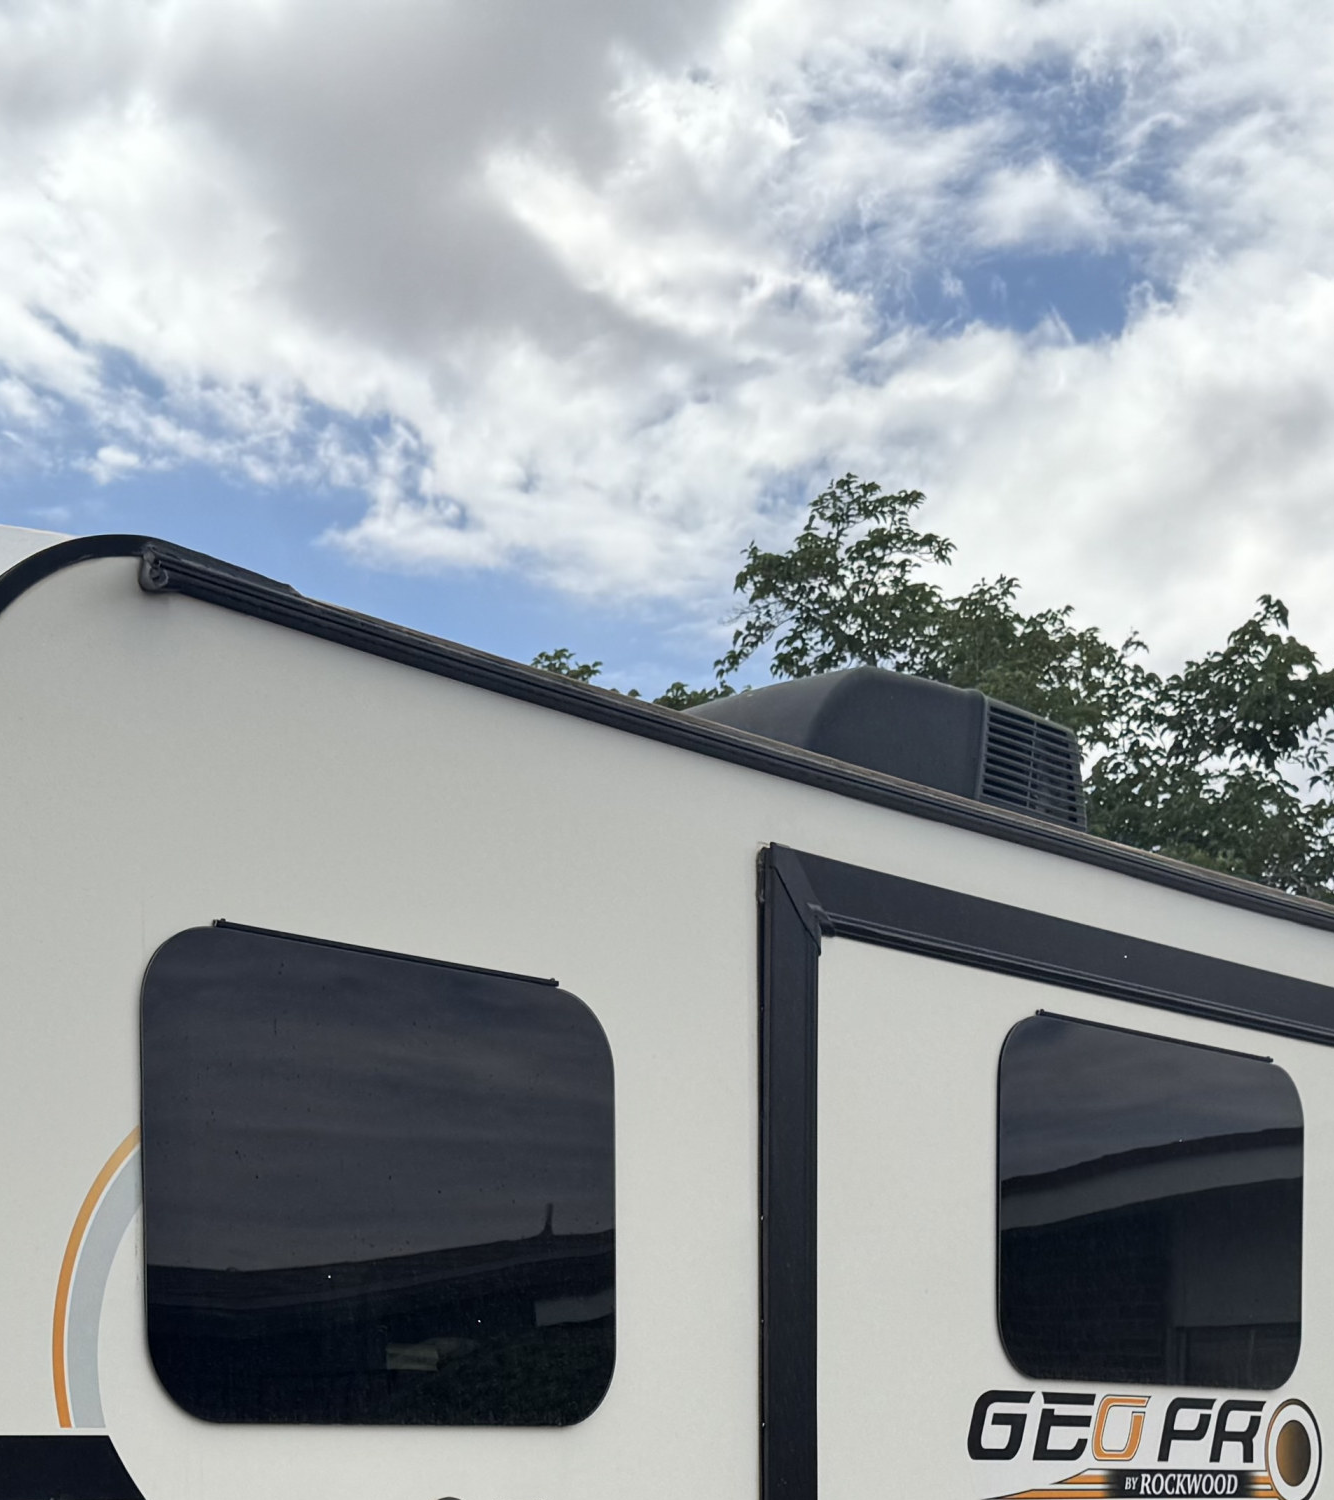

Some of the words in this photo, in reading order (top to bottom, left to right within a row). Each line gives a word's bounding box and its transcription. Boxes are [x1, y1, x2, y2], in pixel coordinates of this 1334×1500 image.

[966, 1389, 1153, 1462] GEO
[1124, 1476, 1139, 1492] BY
[1139, 1472, 1239, 1496] ROCKWOOD
